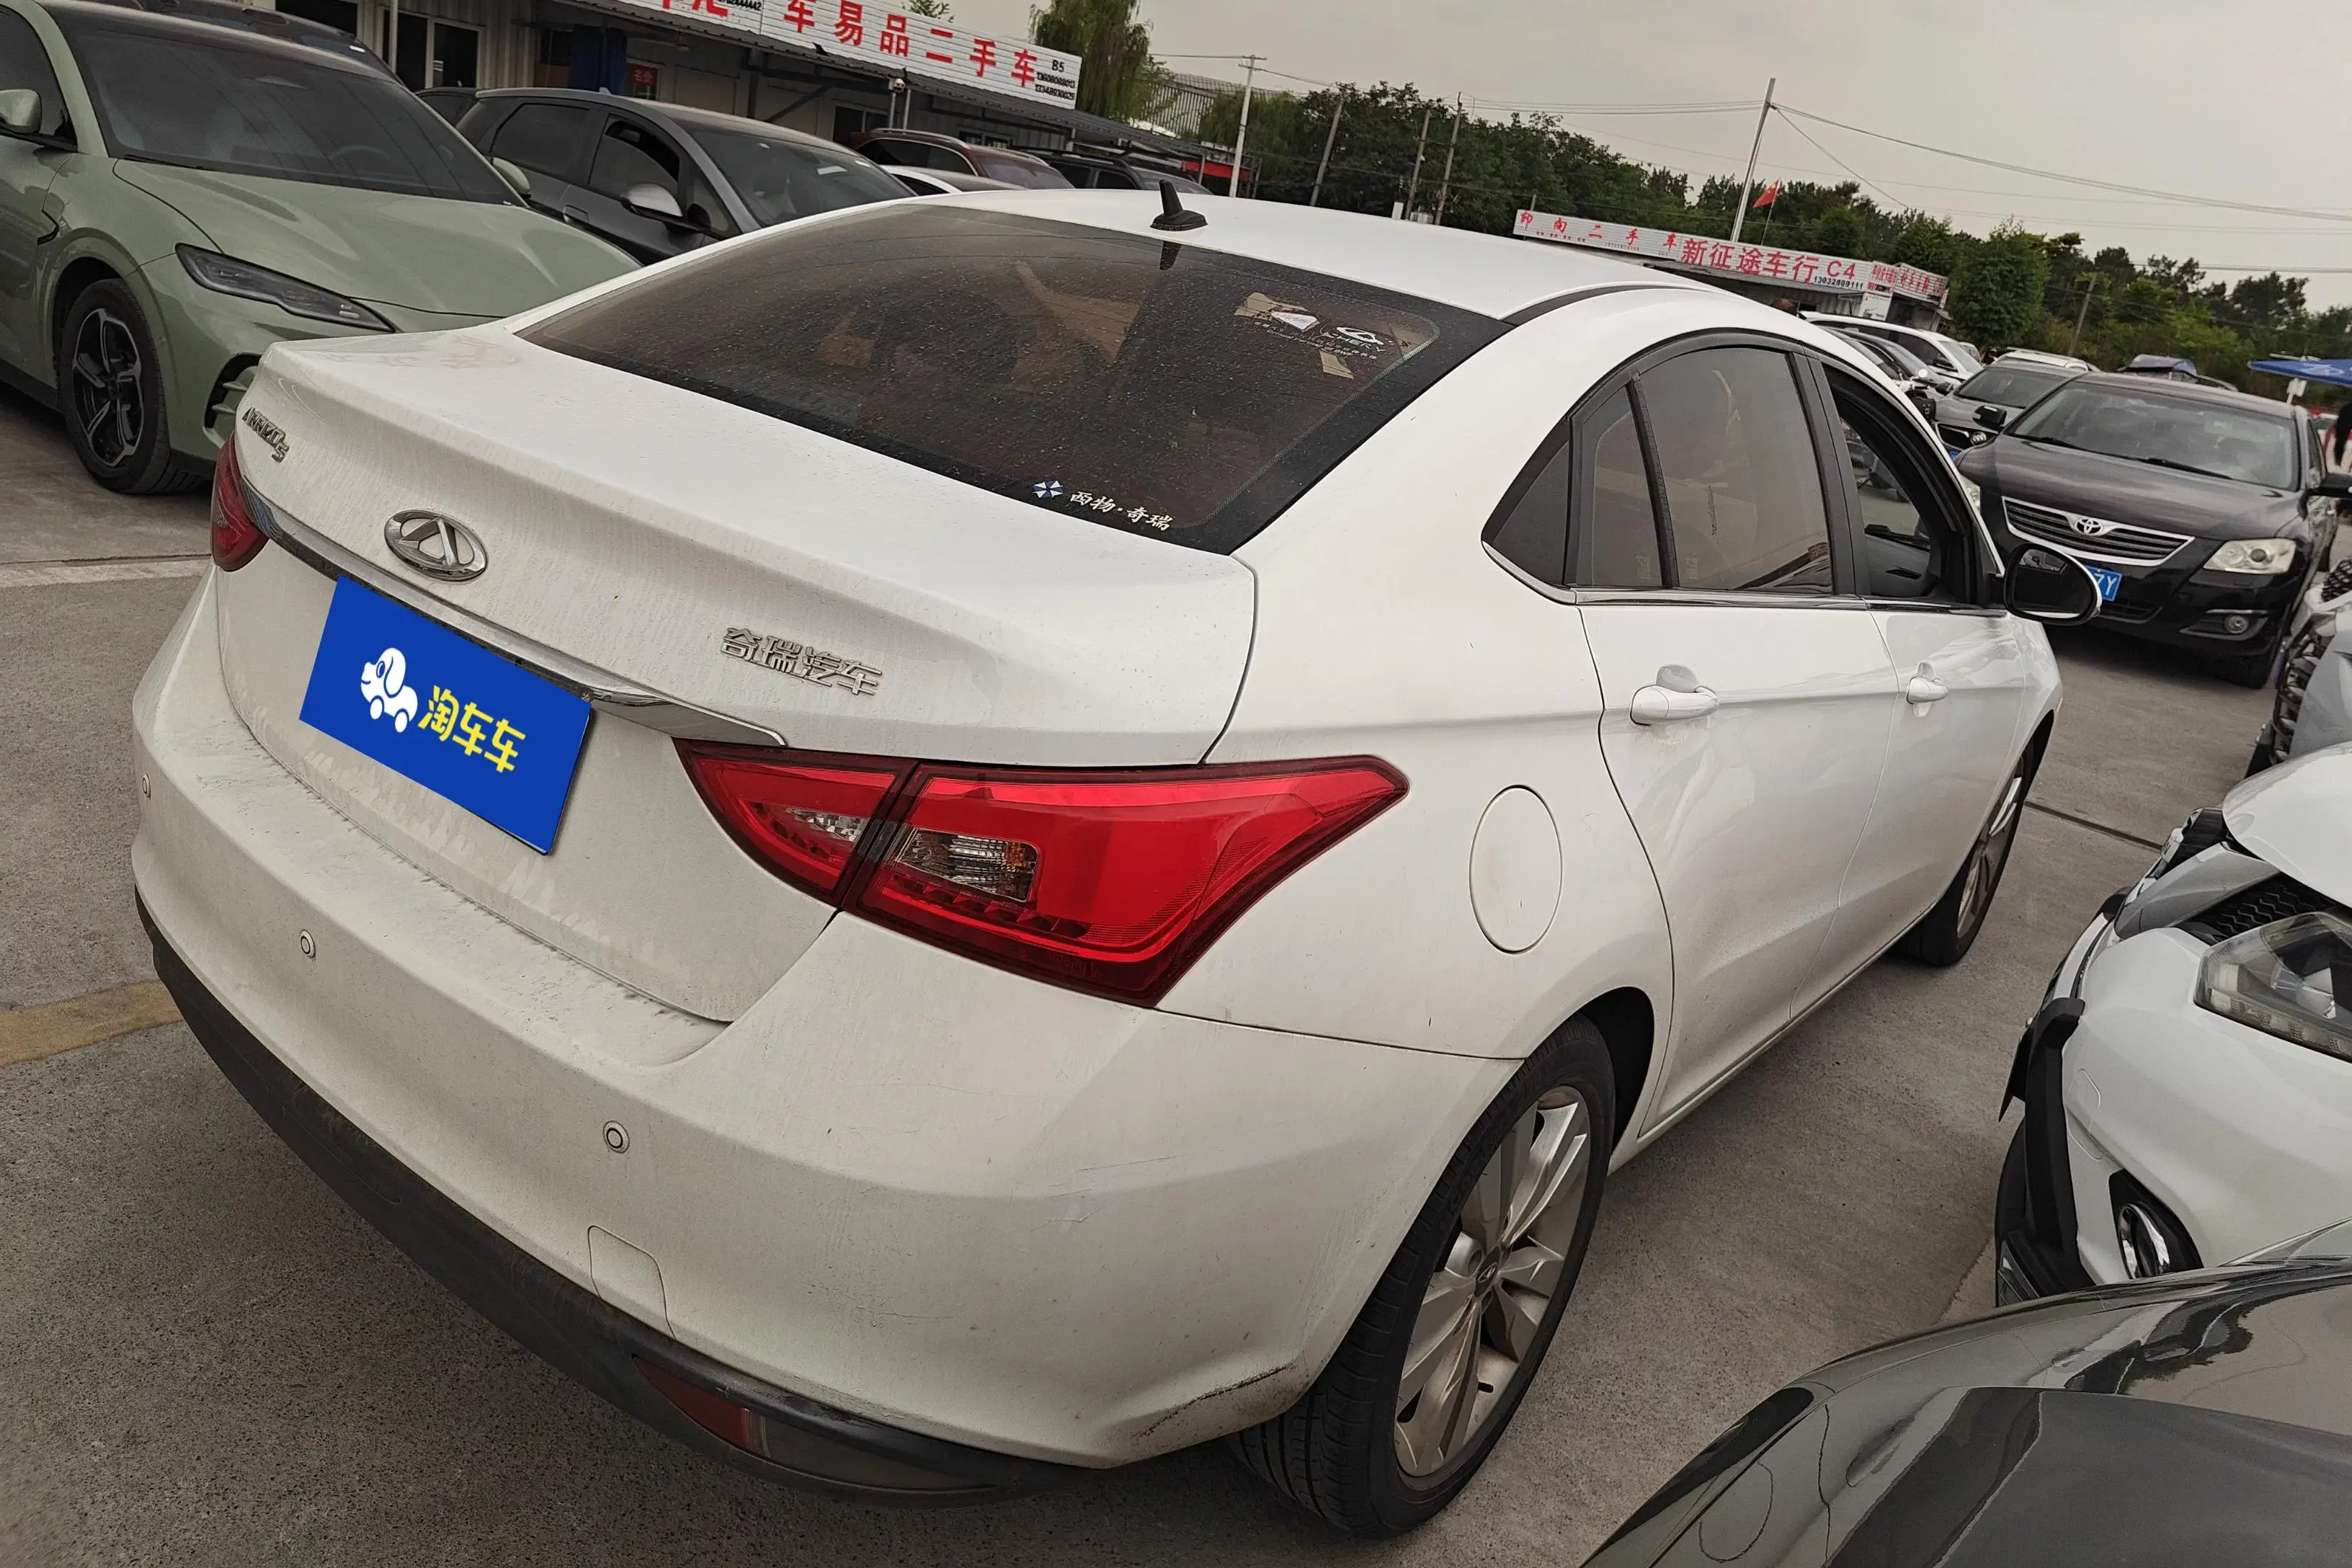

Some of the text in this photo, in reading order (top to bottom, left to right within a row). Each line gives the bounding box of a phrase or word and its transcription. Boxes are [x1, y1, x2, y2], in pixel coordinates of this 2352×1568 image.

[1051, 59, 1065, 73] B5
[1680, 238, 1819, 284] 新征途车行
[1827, 259, 1856, 280] C4
[721, 625, 883, 695] 奇瑞汽车
